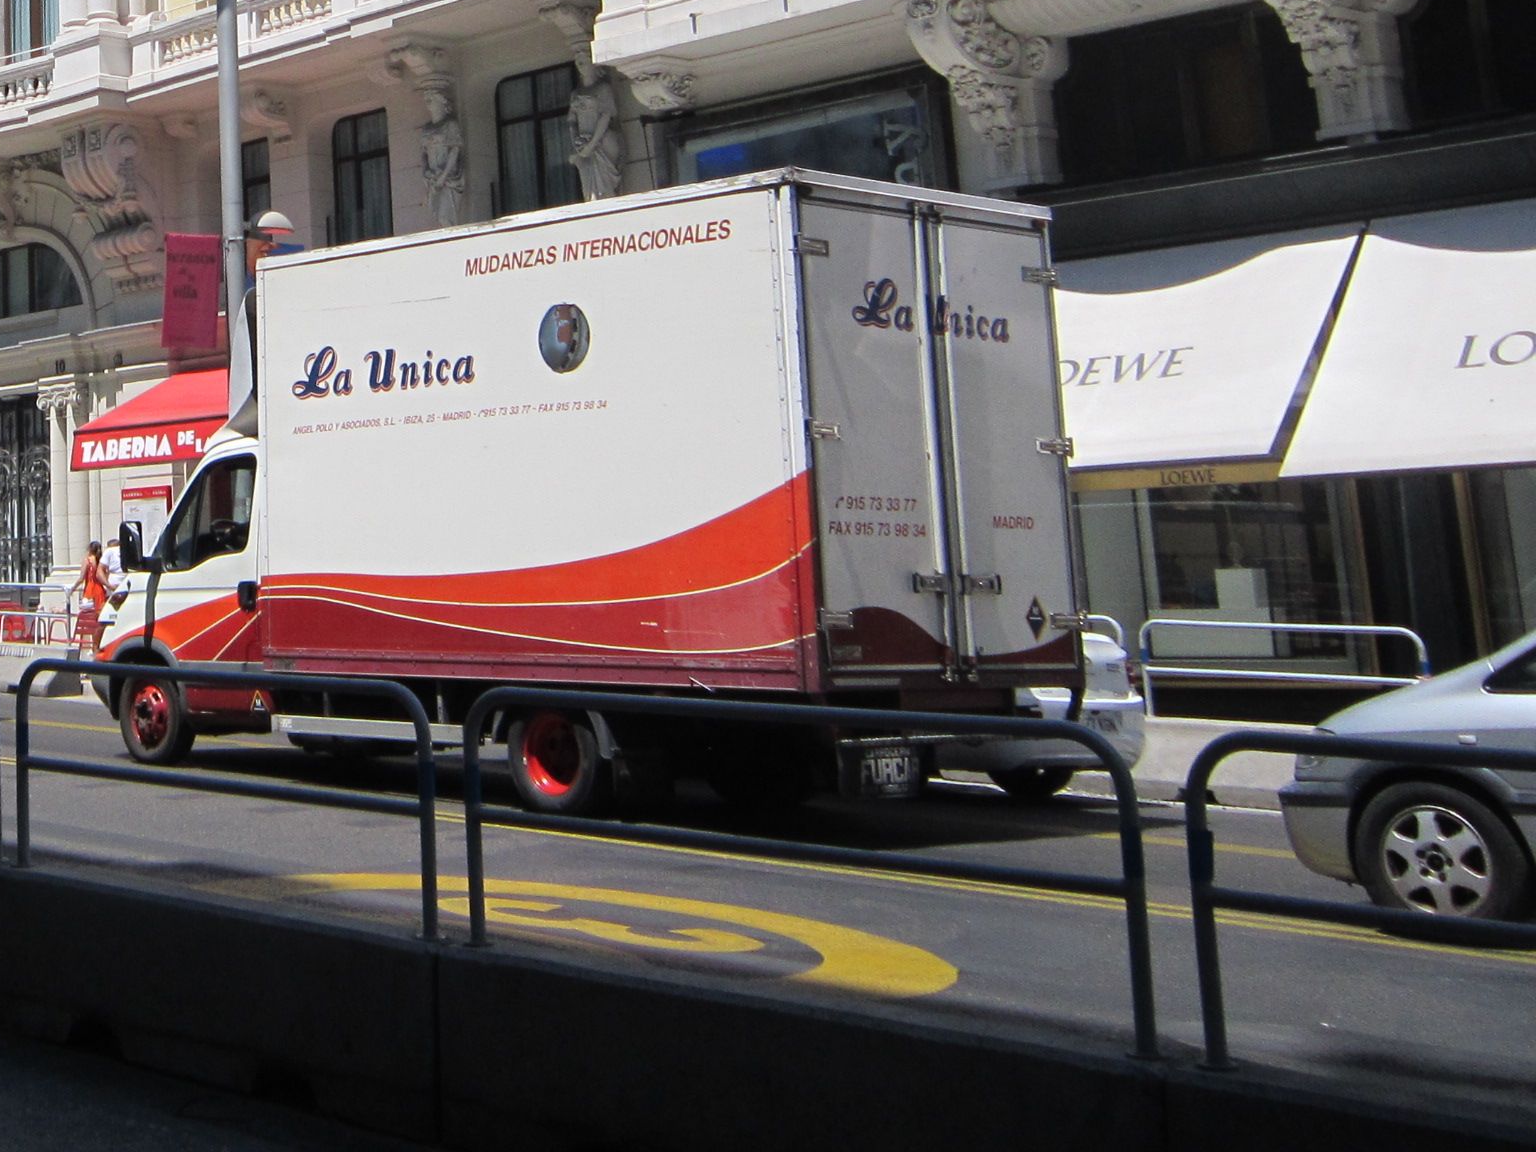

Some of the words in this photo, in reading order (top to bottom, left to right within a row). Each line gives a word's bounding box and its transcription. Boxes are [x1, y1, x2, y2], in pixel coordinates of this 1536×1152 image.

[465, 245, 558, 277] MUDANZAS
[563, 219, 732, 263] INTERNACIONALES
[852, 278, 914, 333] La
[292, 346, 353, 400] La
[364, 348, 475, 393] Unica
[292, 425, 314, 436] ANGEL
[315, 423, 334, 433] POLO
[442, 410, 472, 422] MADRID
[538, 403, 555, 414] FAX
[81, 434, 172, 464] TABERNA
[177, 430, 195, 446] DE
[1160, 469, 1217, 486] LOEWE
[846, 497, 865, 510] 915
[869, 496, 883, 511] 73
[886, 497, 901, 512] 33
[903, 498, 917, 511] 77
[828, 521, 852, 536] FAX
[856, 522, 874, 536] 915
[878, 522, 891, 537] 73
[894, 523, 909, 538] 98
[912, 524, 927, 538] 34
[992, 516, 1035, 531] MADRID
